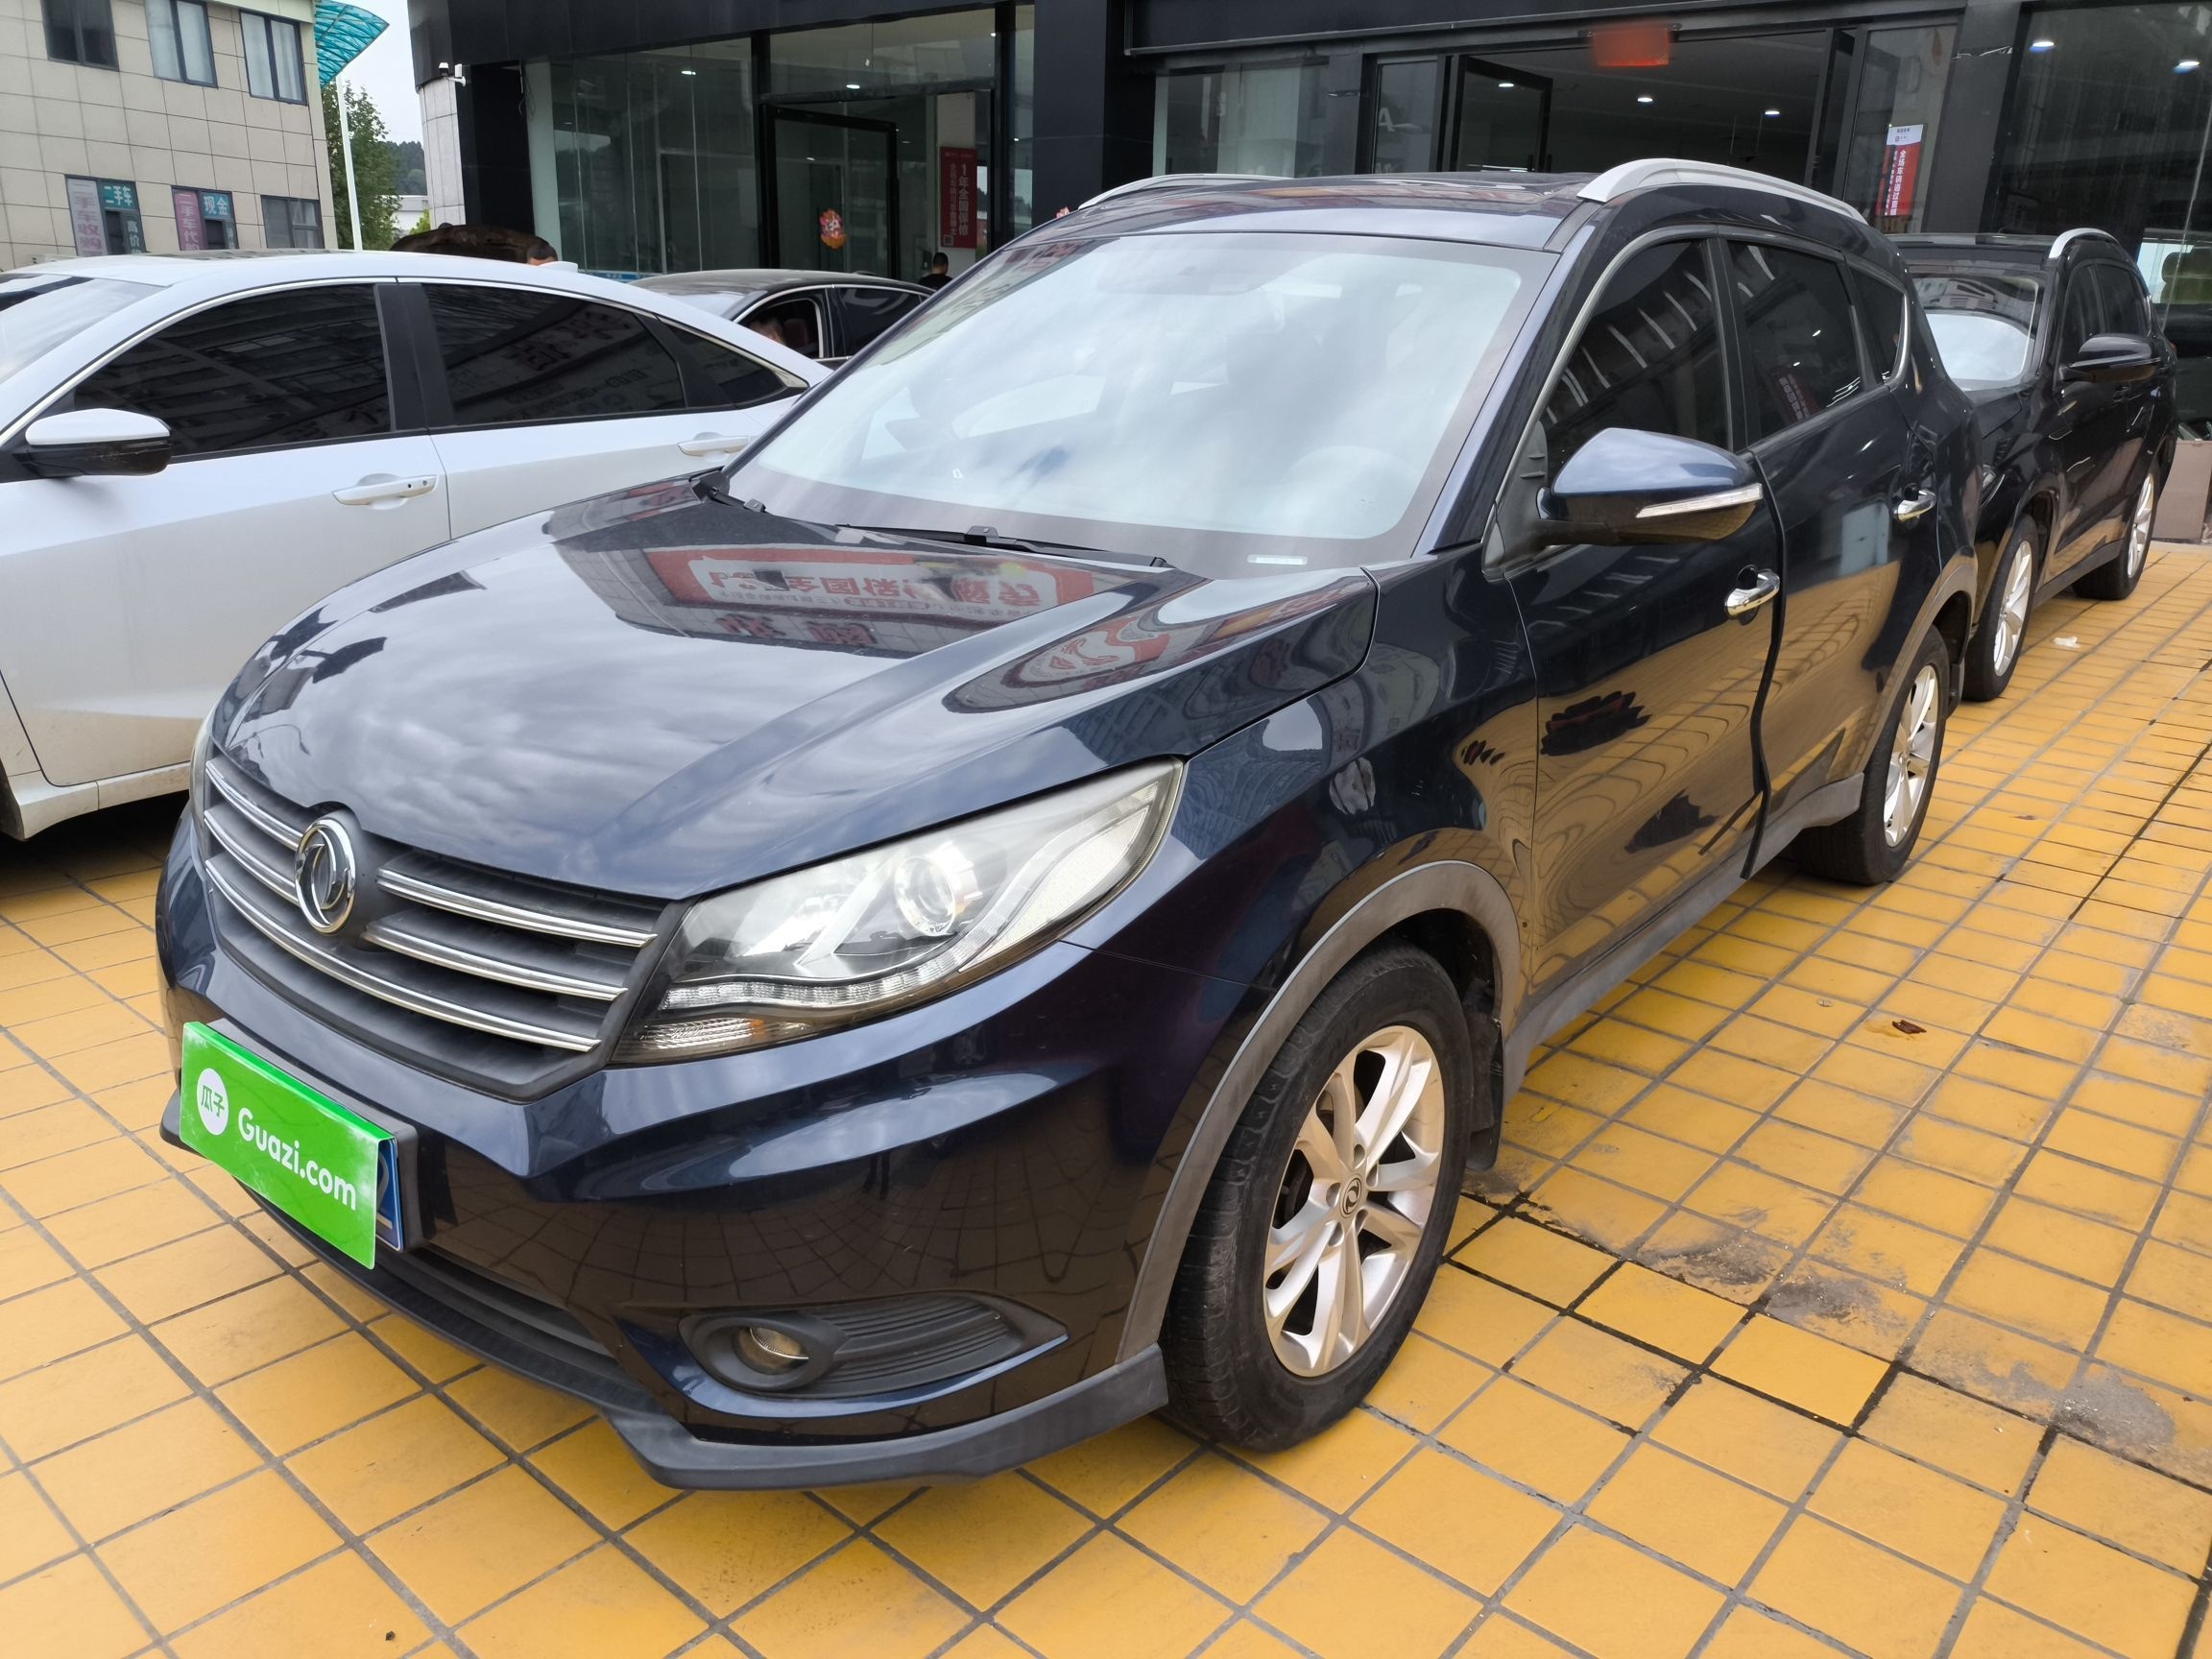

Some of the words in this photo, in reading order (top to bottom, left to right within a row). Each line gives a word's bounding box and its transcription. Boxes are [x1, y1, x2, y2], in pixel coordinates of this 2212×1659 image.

[104, 185, 132, 206] 二手车
[203, 195, 228, 216] 现金
[72, 182, 103, 255] 二手车收购
[199, 1084, 226, 1118] 瓜子
[237, 1107, 358, 1212] Guazi.com
